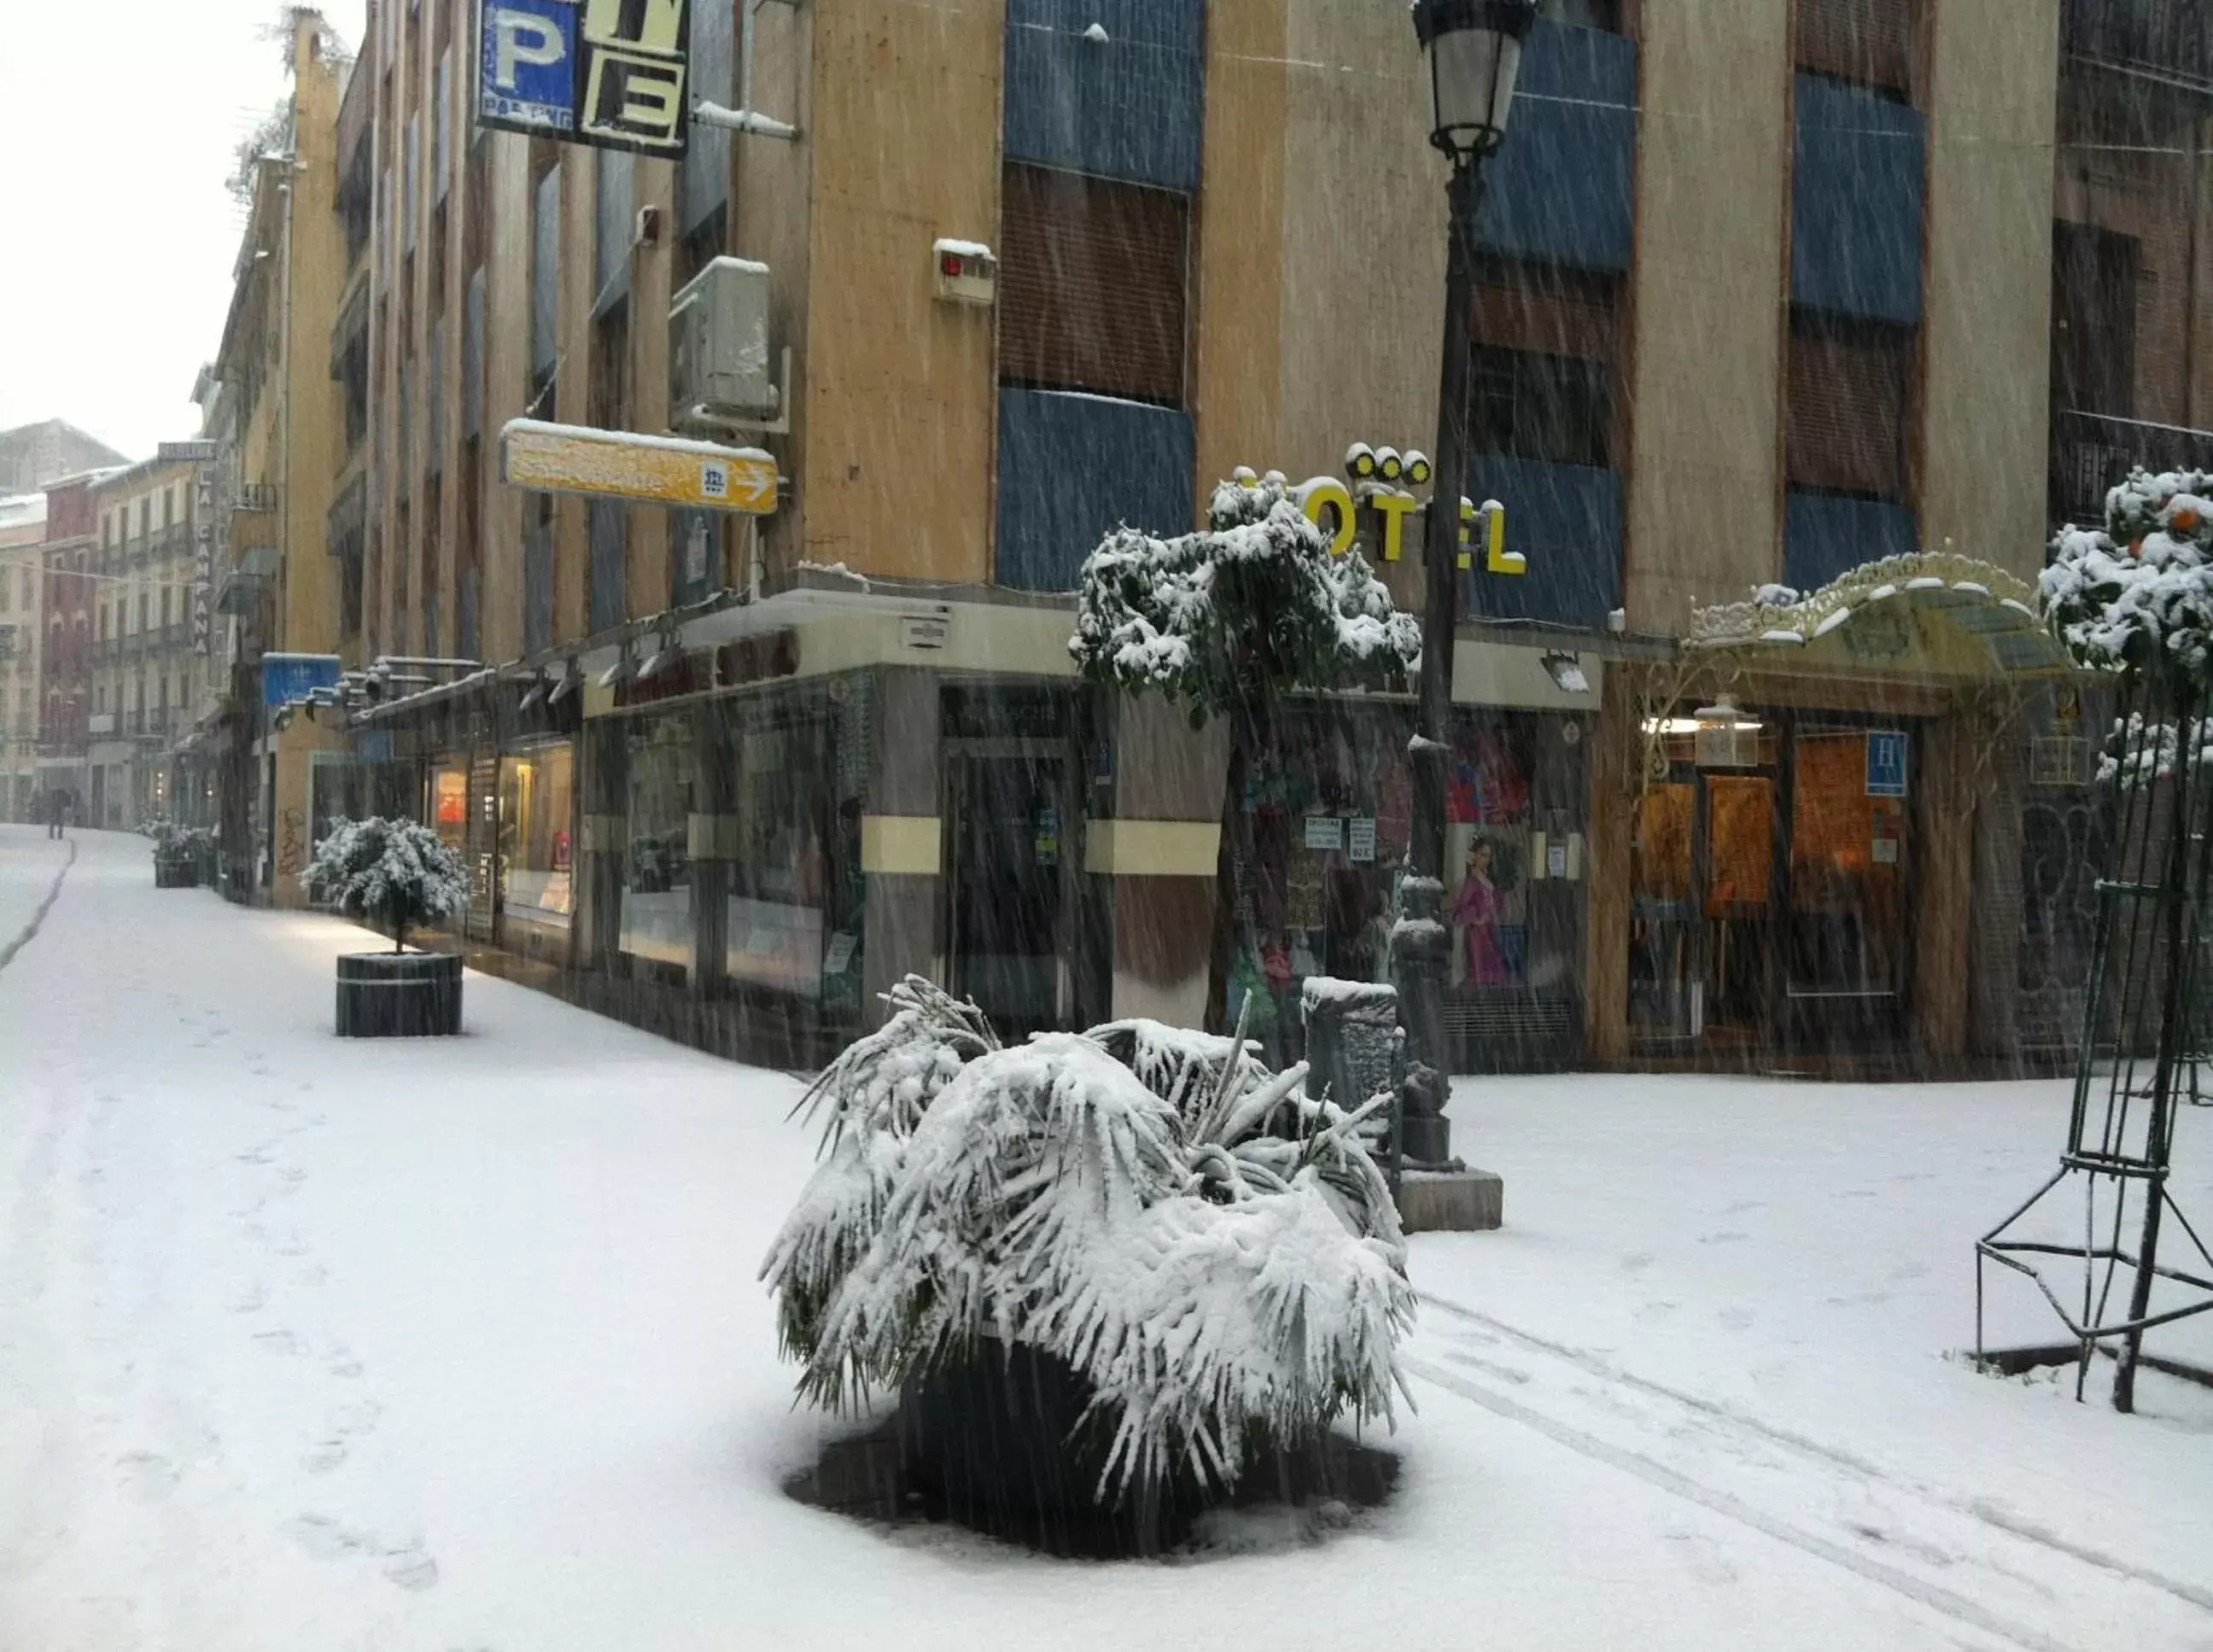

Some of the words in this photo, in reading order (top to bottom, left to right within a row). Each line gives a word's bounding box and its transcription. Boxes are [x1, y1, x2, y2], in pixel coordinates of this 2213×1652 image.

[495, 8, 565, 89] P
[199, 471, 212, 505] LA
[195, 525, 210, 654] CAMPANA
